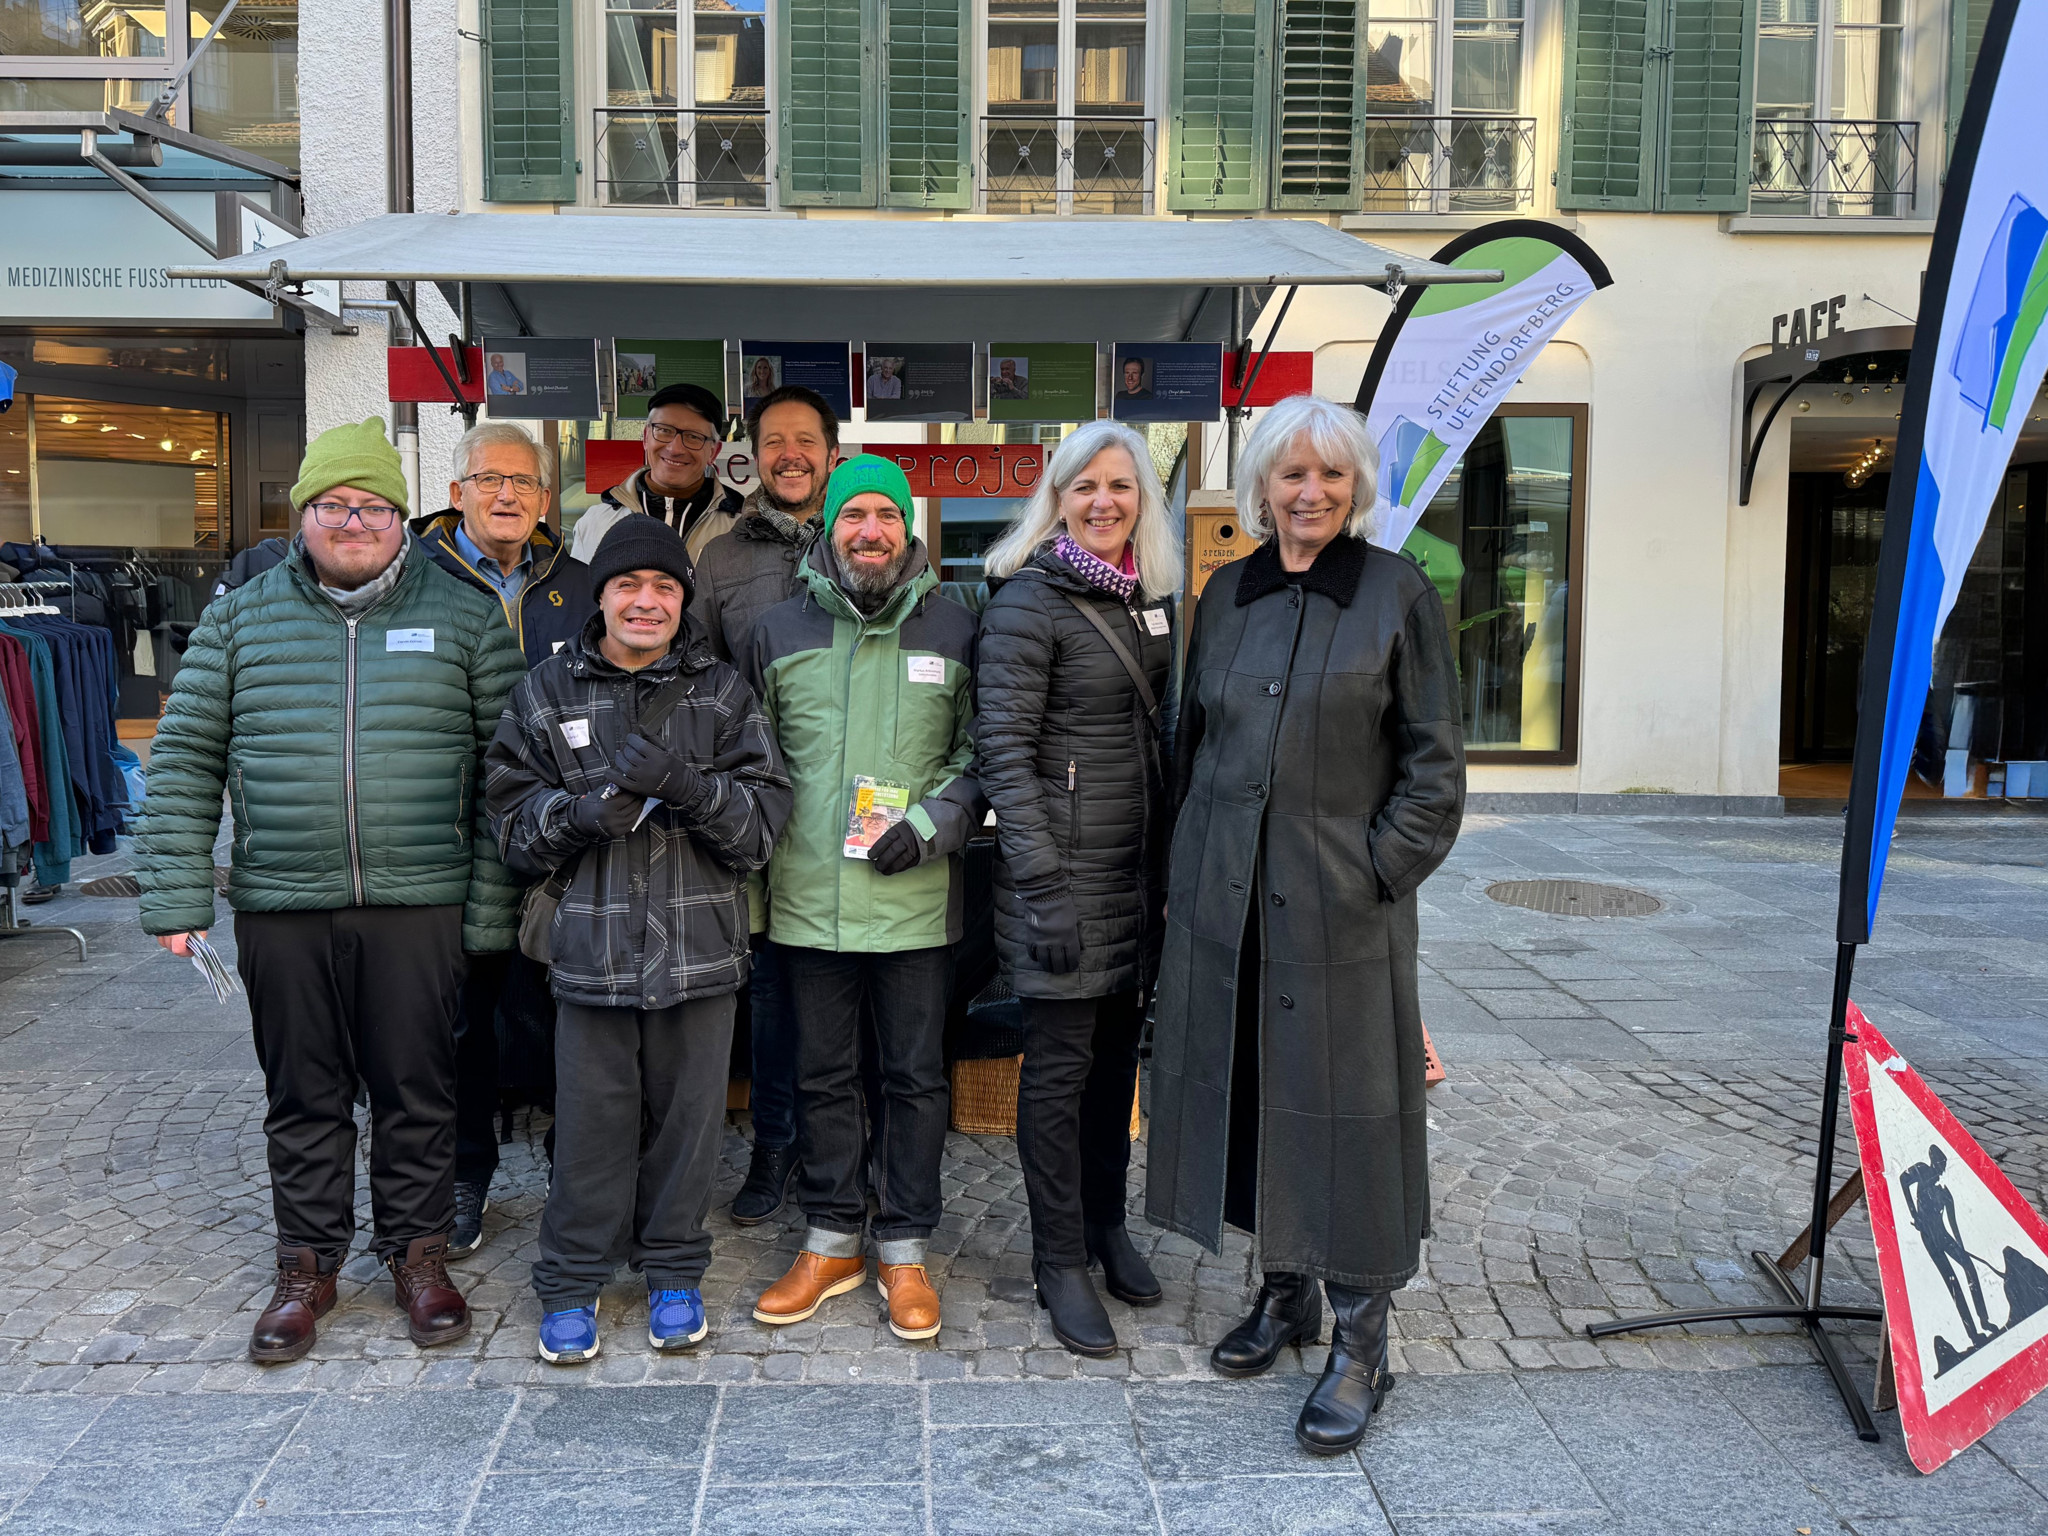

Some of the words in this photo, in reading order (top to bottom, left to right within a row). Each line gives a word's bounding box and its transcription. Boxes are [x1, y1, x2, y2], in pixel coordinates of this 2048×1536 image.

[7, 266, 123, 288] MEDIZINISCHE
[1426, 330, 1502, 420] STIFTUNG
[1446, 281, 1575, 431] UETENDORFBERG
